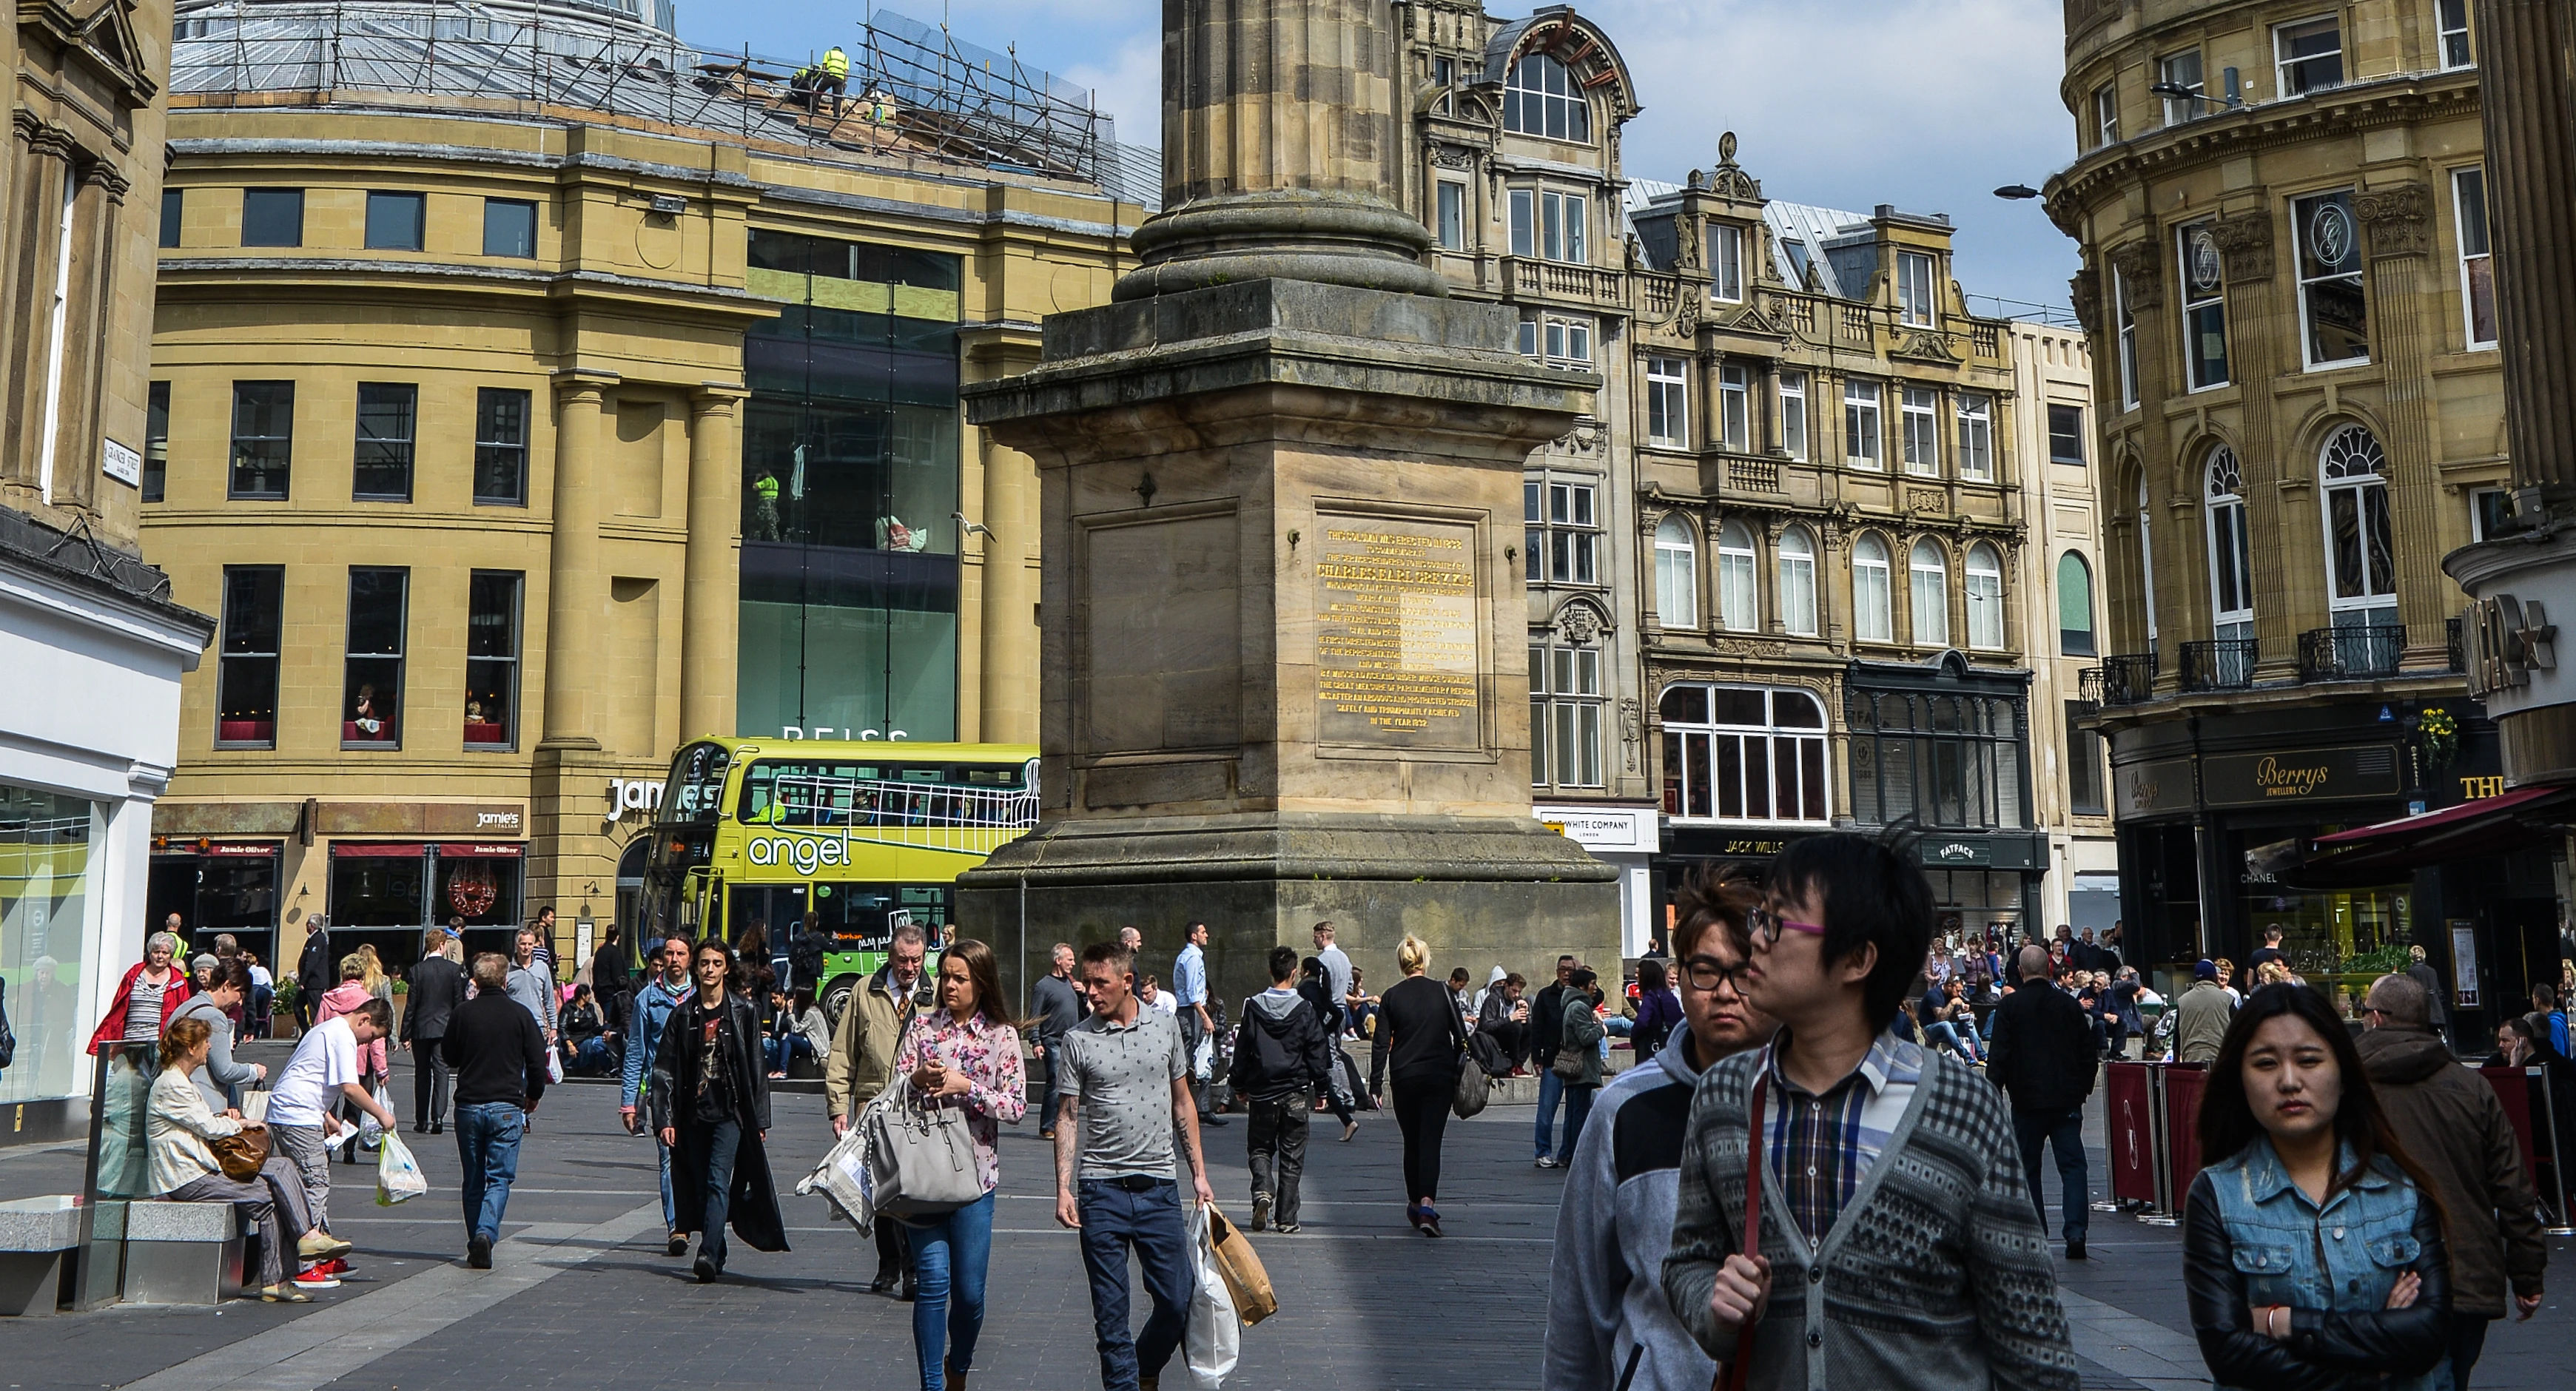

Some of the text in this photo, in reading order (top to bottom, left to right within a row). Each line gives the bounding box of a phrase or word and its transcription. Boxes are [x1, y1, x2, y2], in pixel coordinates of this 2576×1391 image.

[1396, 535, 1432, 548] ERECTED
[1378, 567, 1413, 583] EARL
[1379, 717, 1392, 725] THE
[1855, 769, 1872, 780] 1988
[2257, 756, 2328, 795] Berrys
[2267, 787, 2296, 797] JEWELLERS
[476, 812, 519, 828] Jamie's
[1564, 821, 1628, 829] WHITE COMPANY
[220, 845, 270, 854] Jamie Oliver
[748, 828, 851, 875] angel
[1725, 841, 1784, 853] JACK WILLS
[1940, 843, 1974, 859] FATFACE
[2241, 873, 2277, 883] CHANEL
